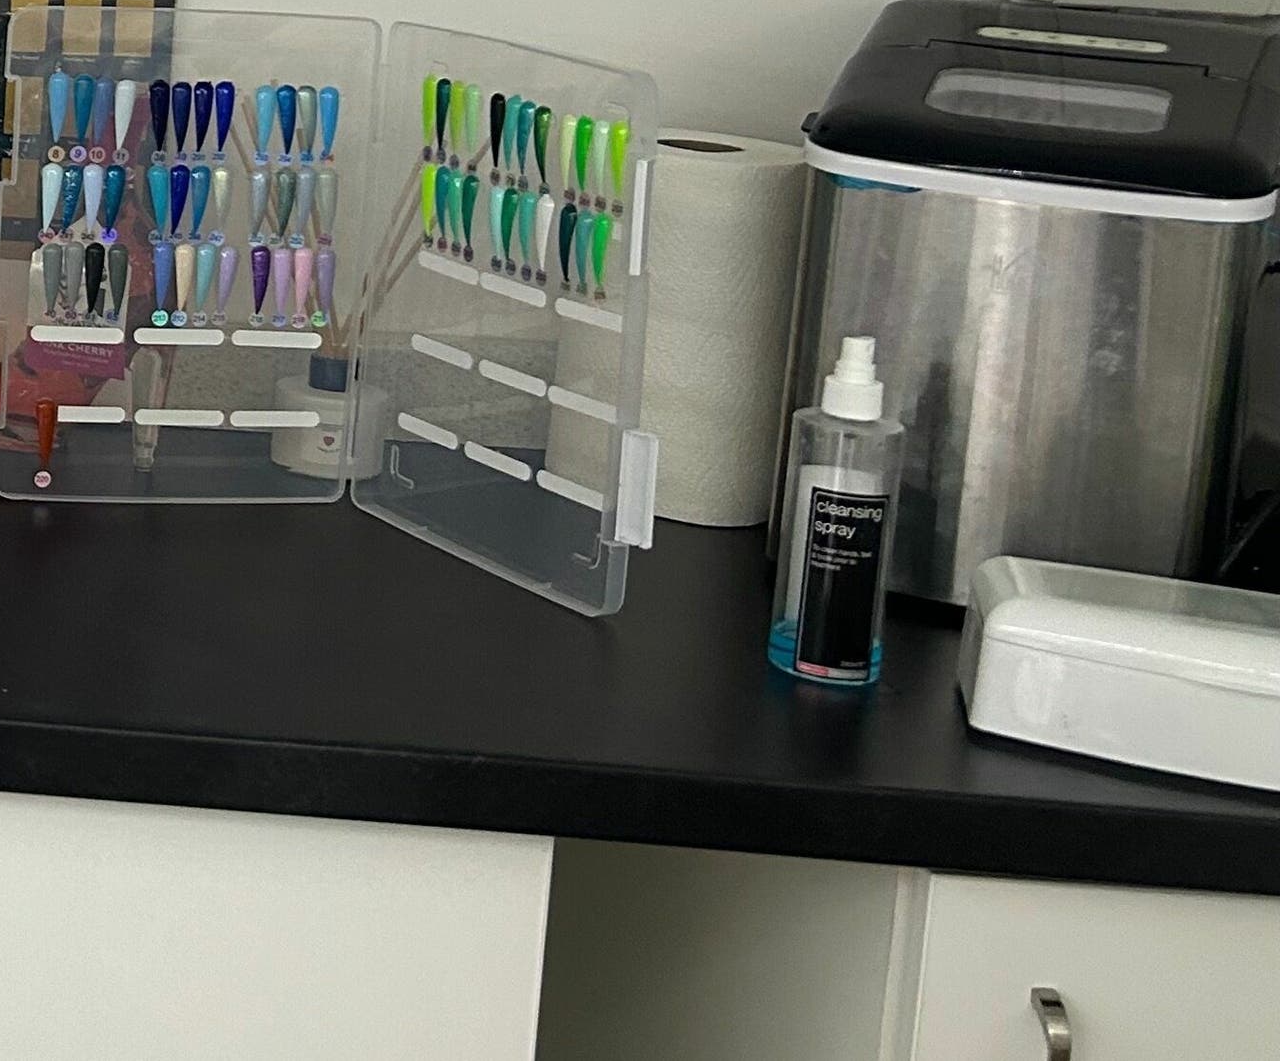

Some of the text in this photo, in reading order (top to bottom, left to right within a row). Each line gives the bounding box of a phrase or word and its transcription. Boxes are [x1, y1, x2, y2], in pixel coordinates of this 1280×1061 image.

[67, 344, 113, 358] CHERRY
[817, 501, 882, 522] cleansing
[815, 520, 856, 540] spray
